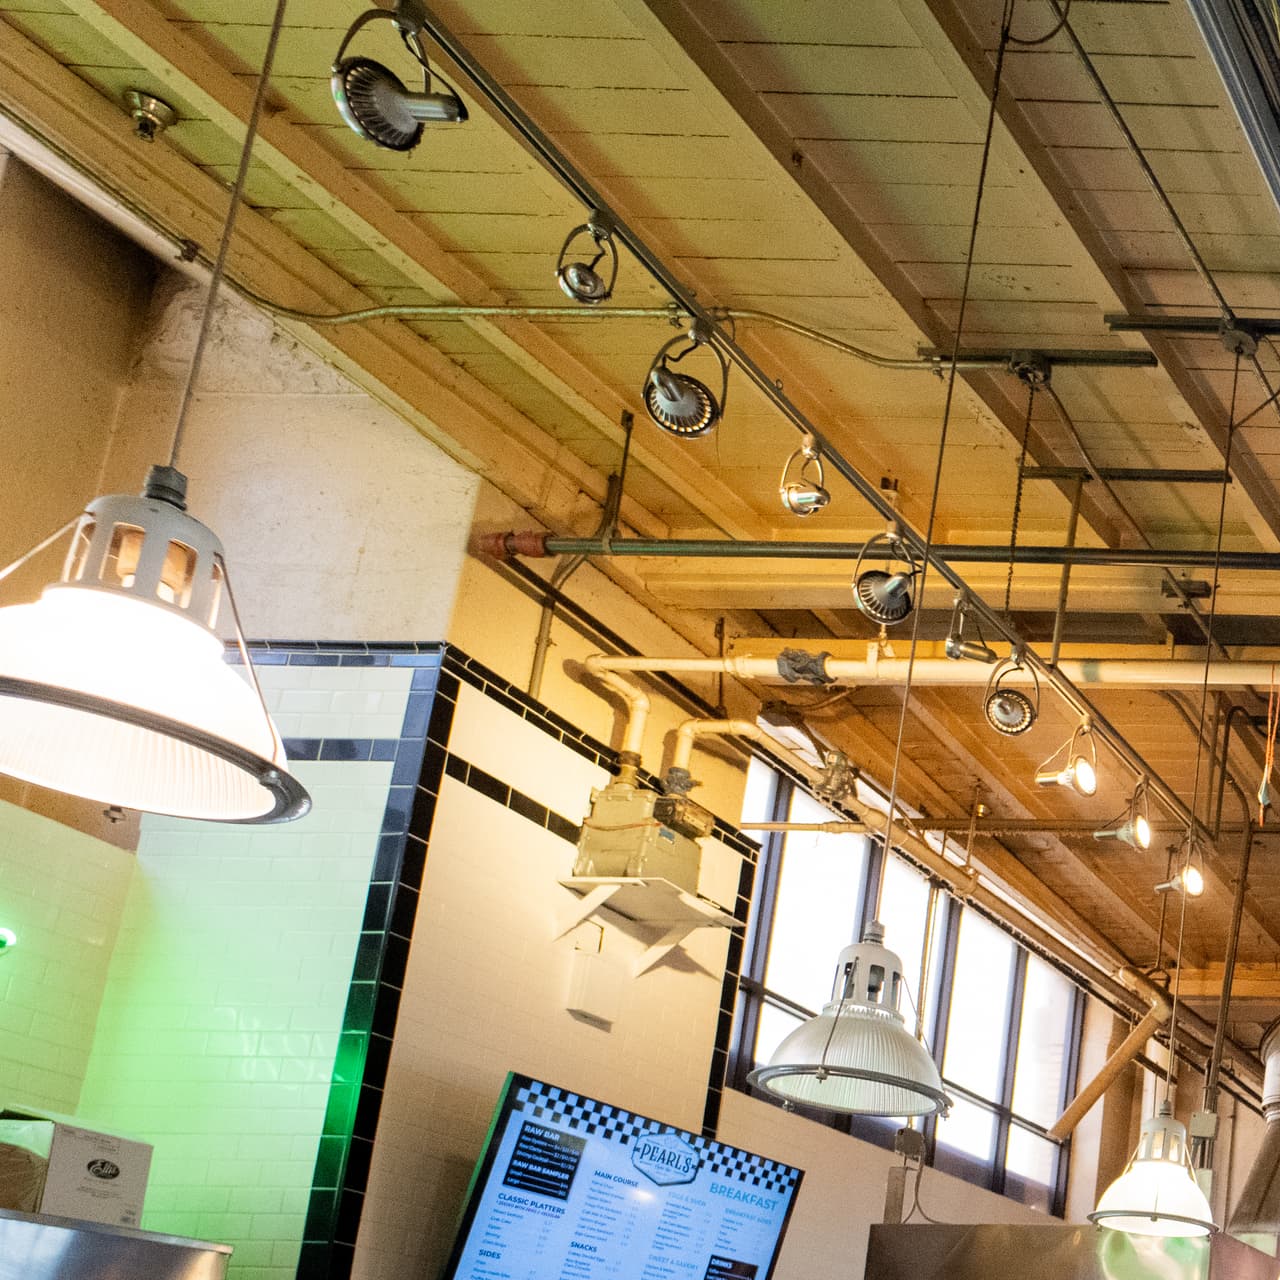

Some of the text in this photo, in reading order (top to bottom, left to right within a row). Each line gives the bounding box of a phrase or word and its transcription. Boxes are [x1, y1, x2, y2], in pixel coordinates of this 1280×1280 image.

[524, 1125, 560, 1141] RAW BAR
[594, 1170, 639, 1187] MAIN COURSE
[498, 1192, 566, 1215] CLASSIC PLATTERS
[709, 1183, 778, 1210] BREAKFAST
[479, 1249, 501, 1260] SIDES
[571, 1241, 597, 1253] SNACKS
